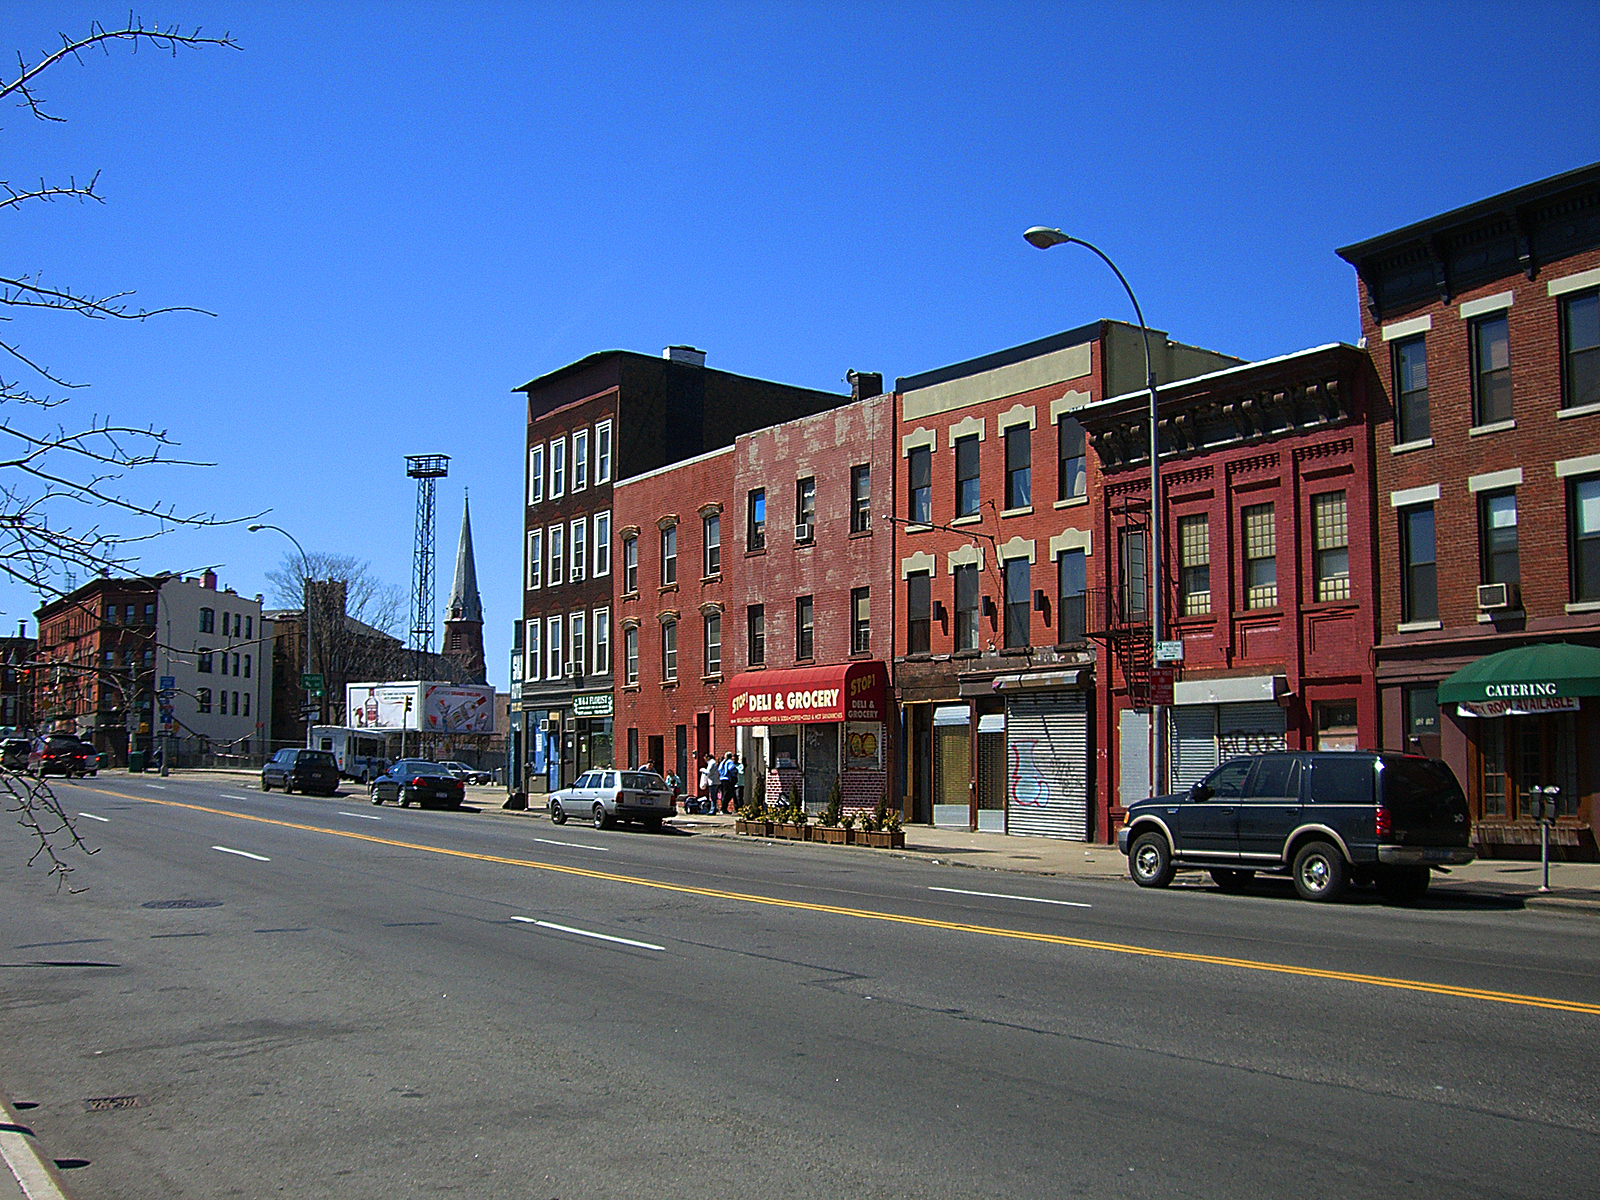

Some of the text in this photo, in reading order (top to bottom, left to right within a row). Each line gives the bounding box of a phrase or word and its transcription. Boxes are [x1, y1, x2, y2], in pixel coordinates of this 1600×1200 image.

[1485, 682, 1557, 697] CATERING
[731, 688, 840, 714] STOP! DELI & GROCERY
[851, 700, 875, 709] DELI &
[1515, 697, 1574, 711] AVAILABLE
[847, 710, 879, 719] GROCERY
